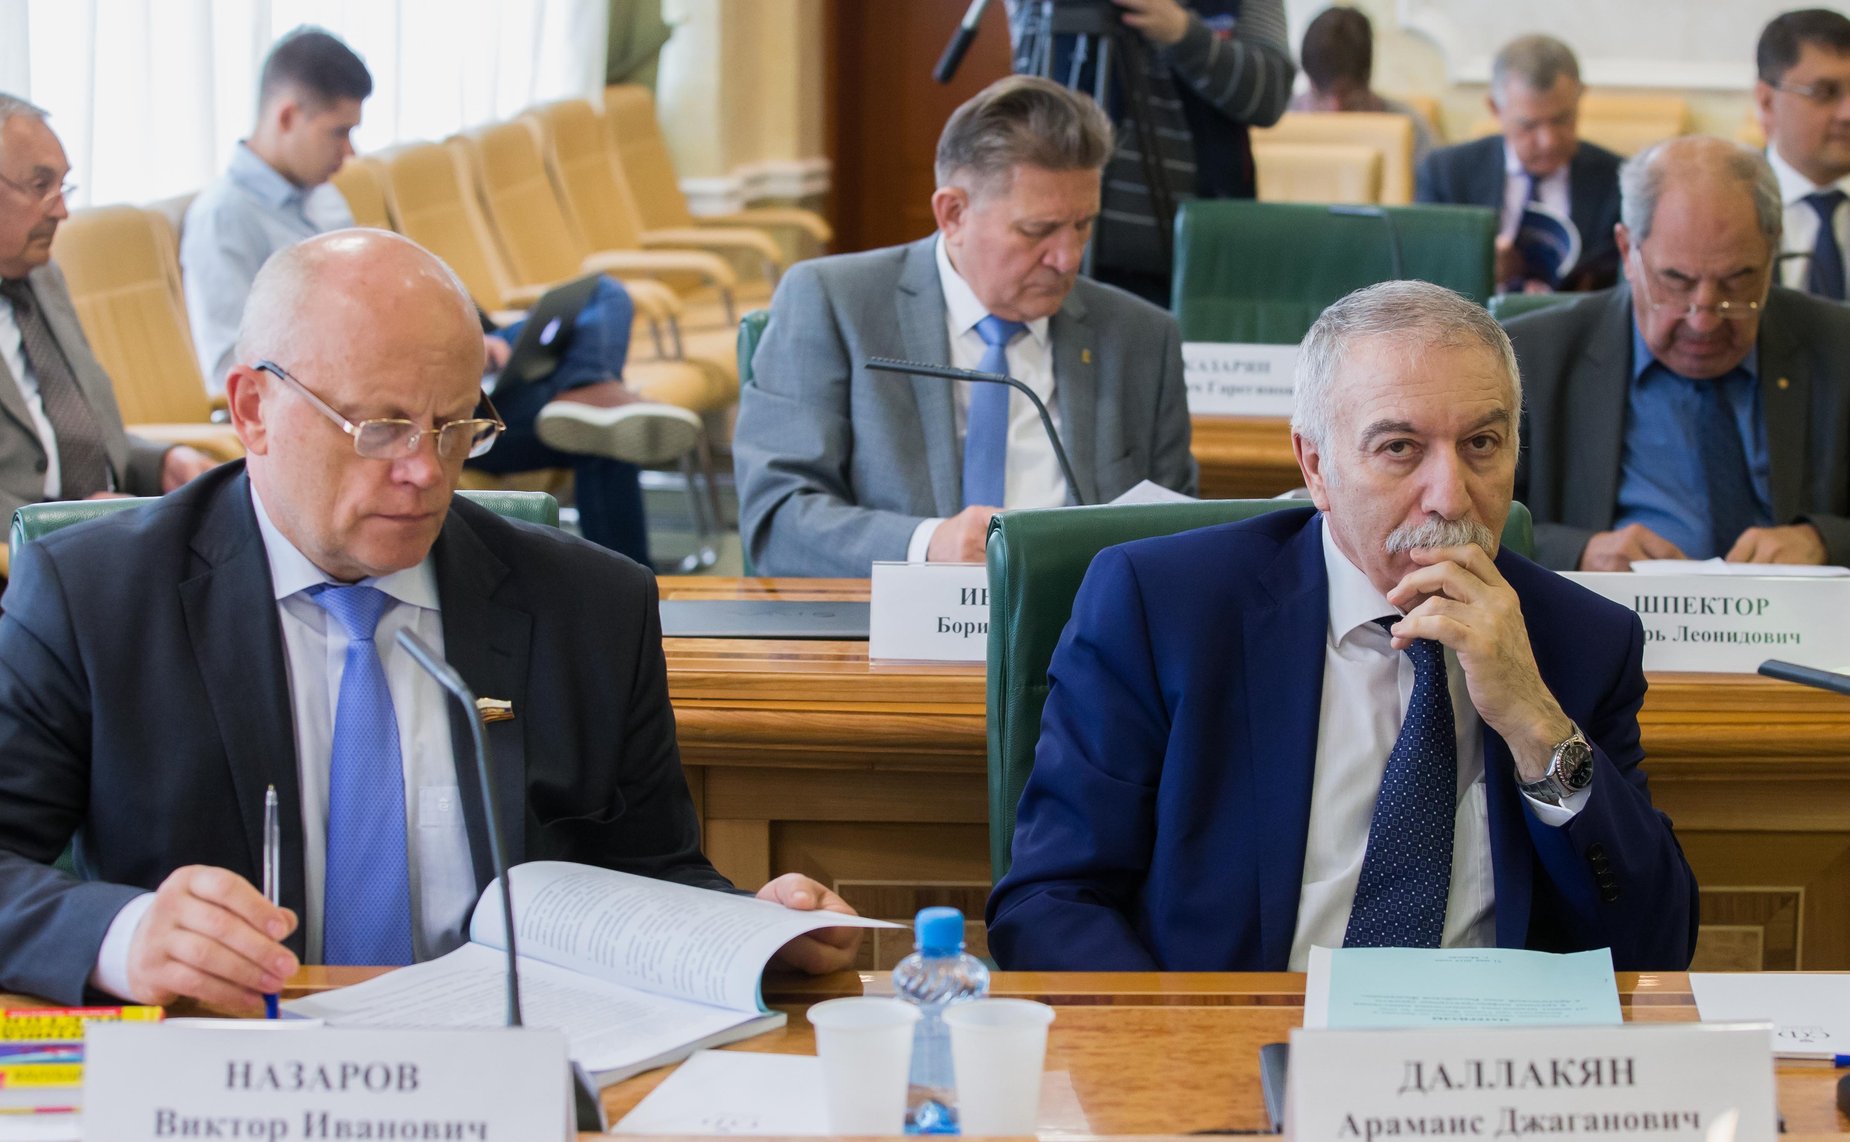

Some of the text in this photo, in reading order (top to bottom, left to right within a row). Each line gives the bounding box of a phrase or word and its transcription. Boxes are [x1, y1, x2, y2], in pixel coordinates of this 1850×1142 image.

[1635, 595, 1770, 616] ШПЕКТОР
[936, 616, 988, 638] Бори
[1673, 625, 1801, 645] Леонидович
[225, 1059, 421, 1093] НАЗАРОВ
[1398, 1058, 1636, 1096] ДАЛЛАКЯН
[154, 1107, 489, 1142] Виктор Иванович
[1338, 1107, 1701, 1142] Арамаис Джаганович
